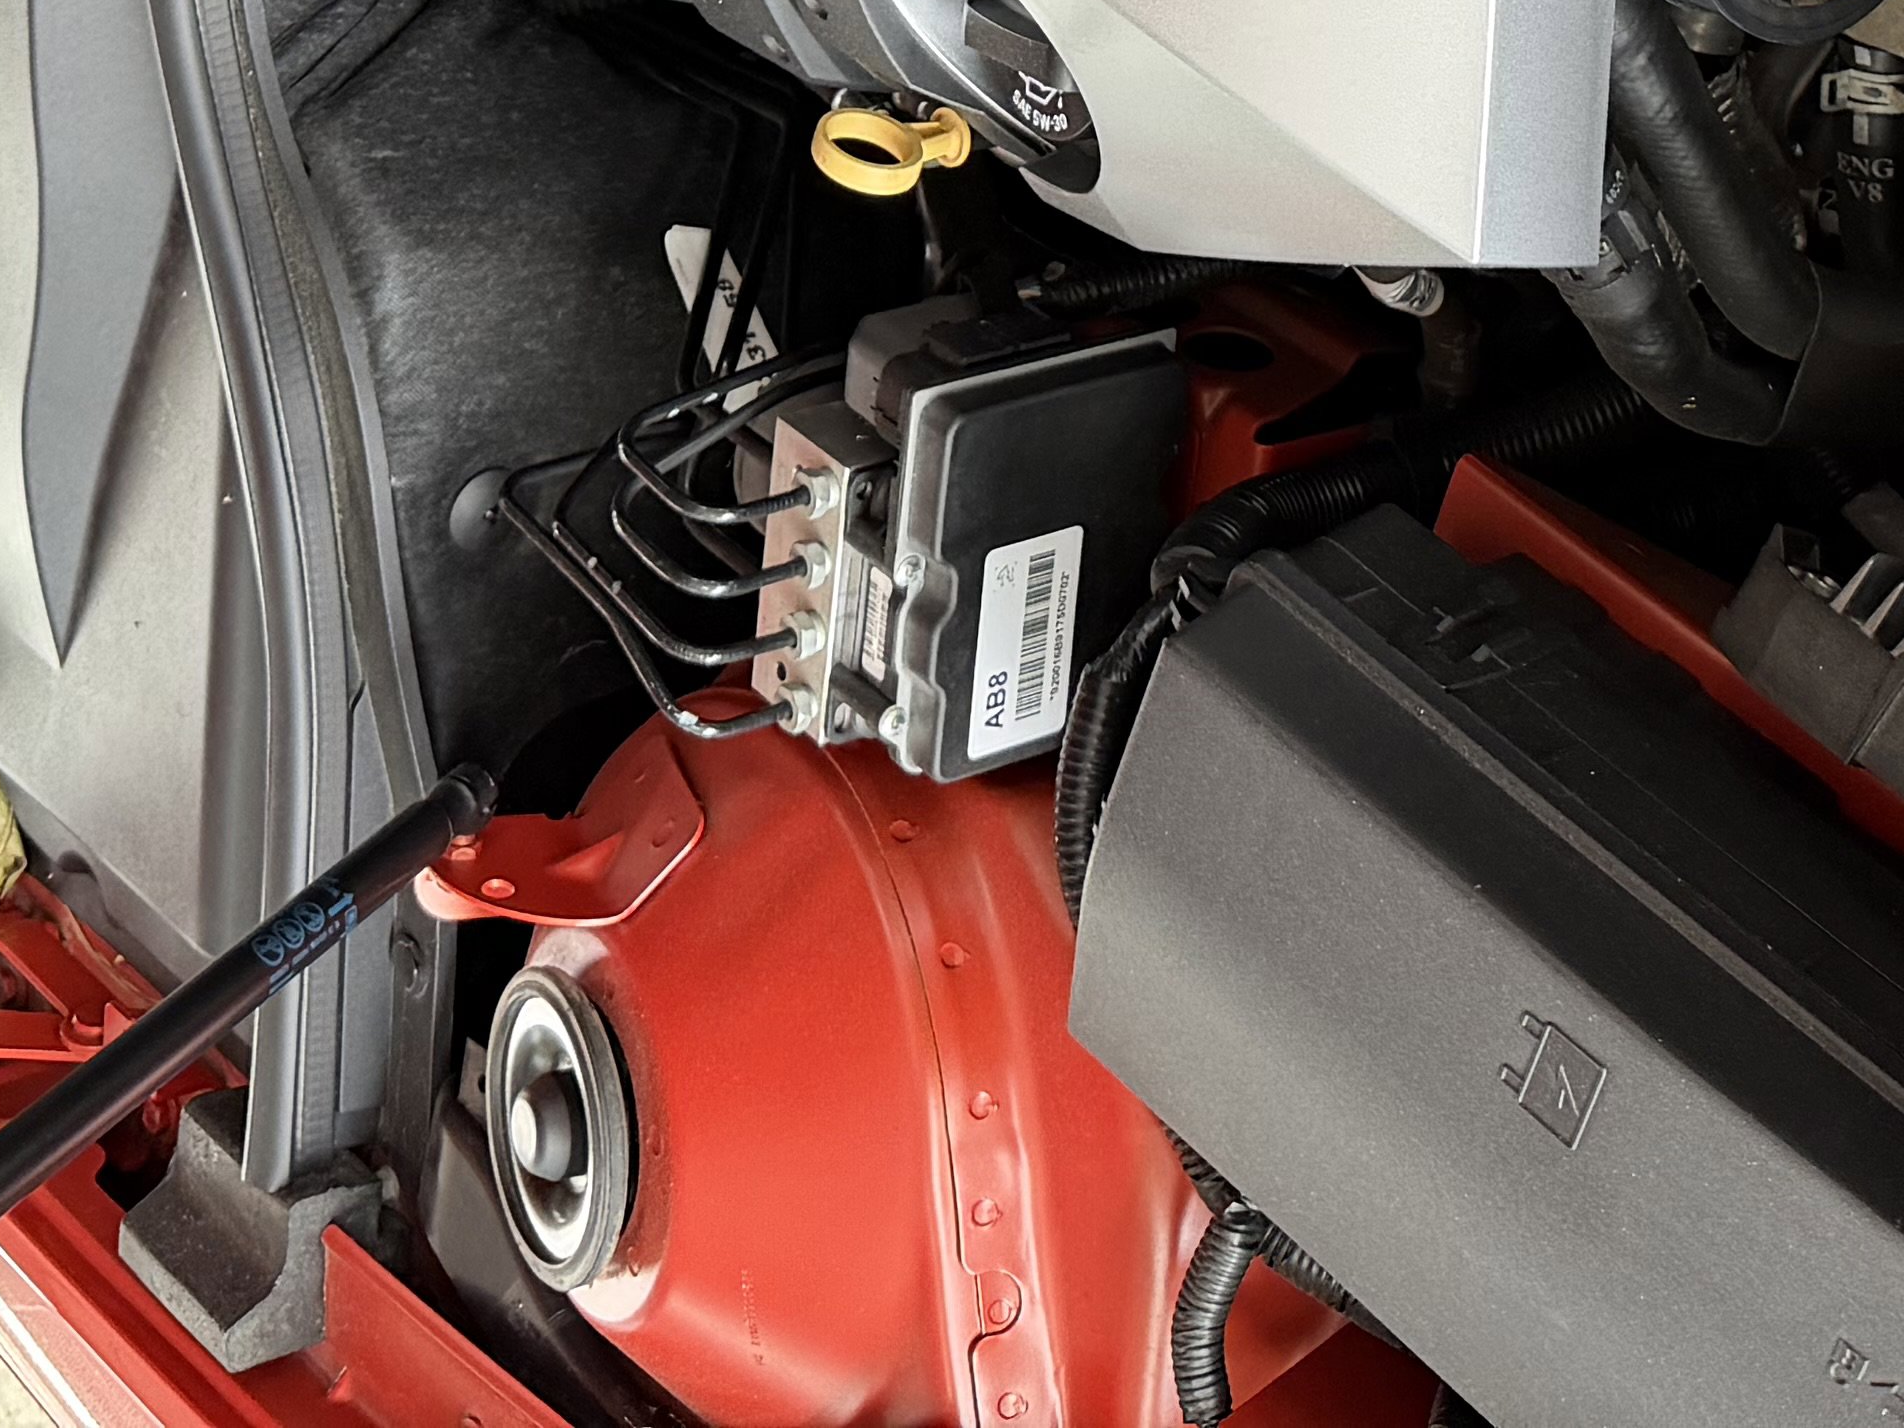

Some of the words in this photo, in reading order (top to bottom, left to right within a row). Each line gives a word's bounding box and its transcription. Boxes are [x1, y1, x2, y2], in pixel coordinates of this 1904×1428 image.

[1012, 88, 1033, 121] SAE
[1031, 109, 1070, 133] 5W-30
[1836, 151, 1895, 179] ENG
[1847, 178, 1884, 203] V8
[983, 670, 1009, 729] AB8
